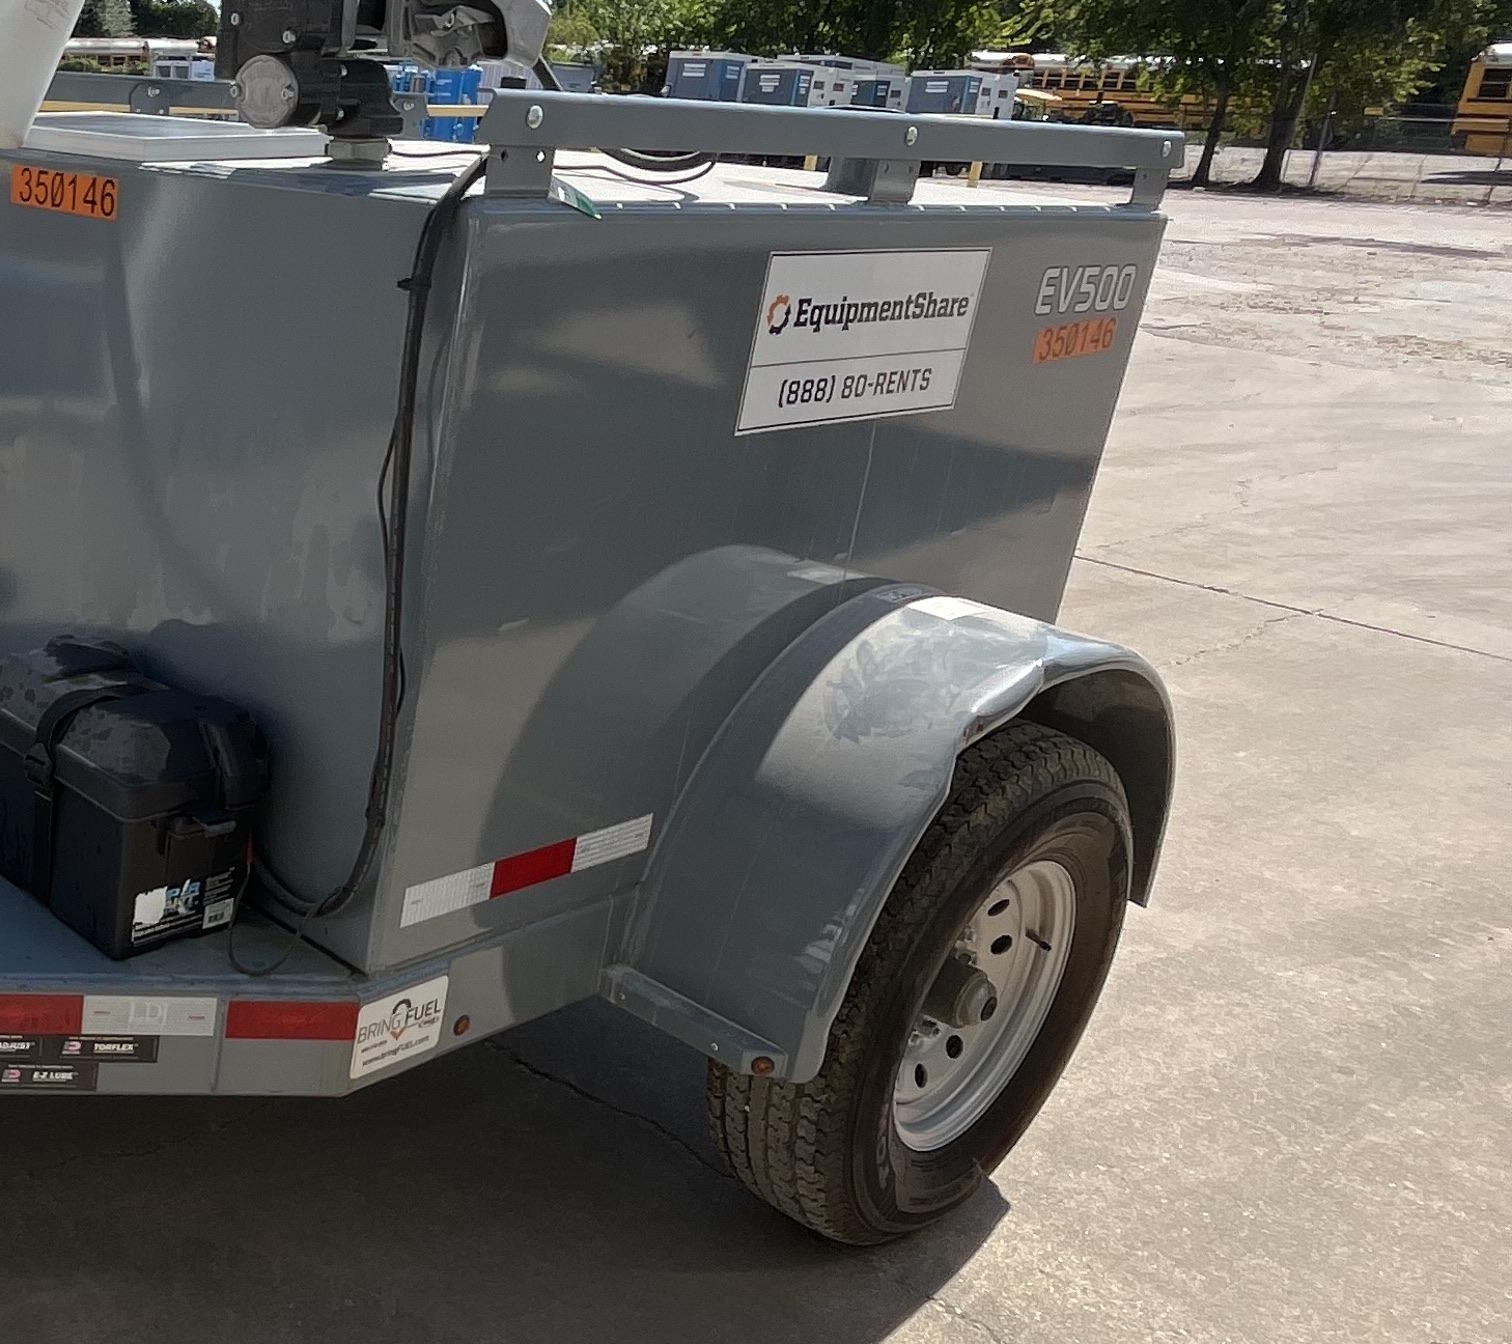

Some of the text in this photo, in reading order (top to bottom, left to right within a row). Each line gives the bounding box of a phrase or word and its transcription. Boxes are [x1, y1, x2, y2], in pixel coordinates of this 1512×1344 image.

[19, 167, 115, 216] 350146
[1034, 263, 1137, 315] EV500
[793, 291, 970, 333] EquipmentShare
[1039, 318, 1116, 361] 350146
[778, 367, 933, 408] (888) 80-RENTS
[405, 998, 442, 1027] FUEL
